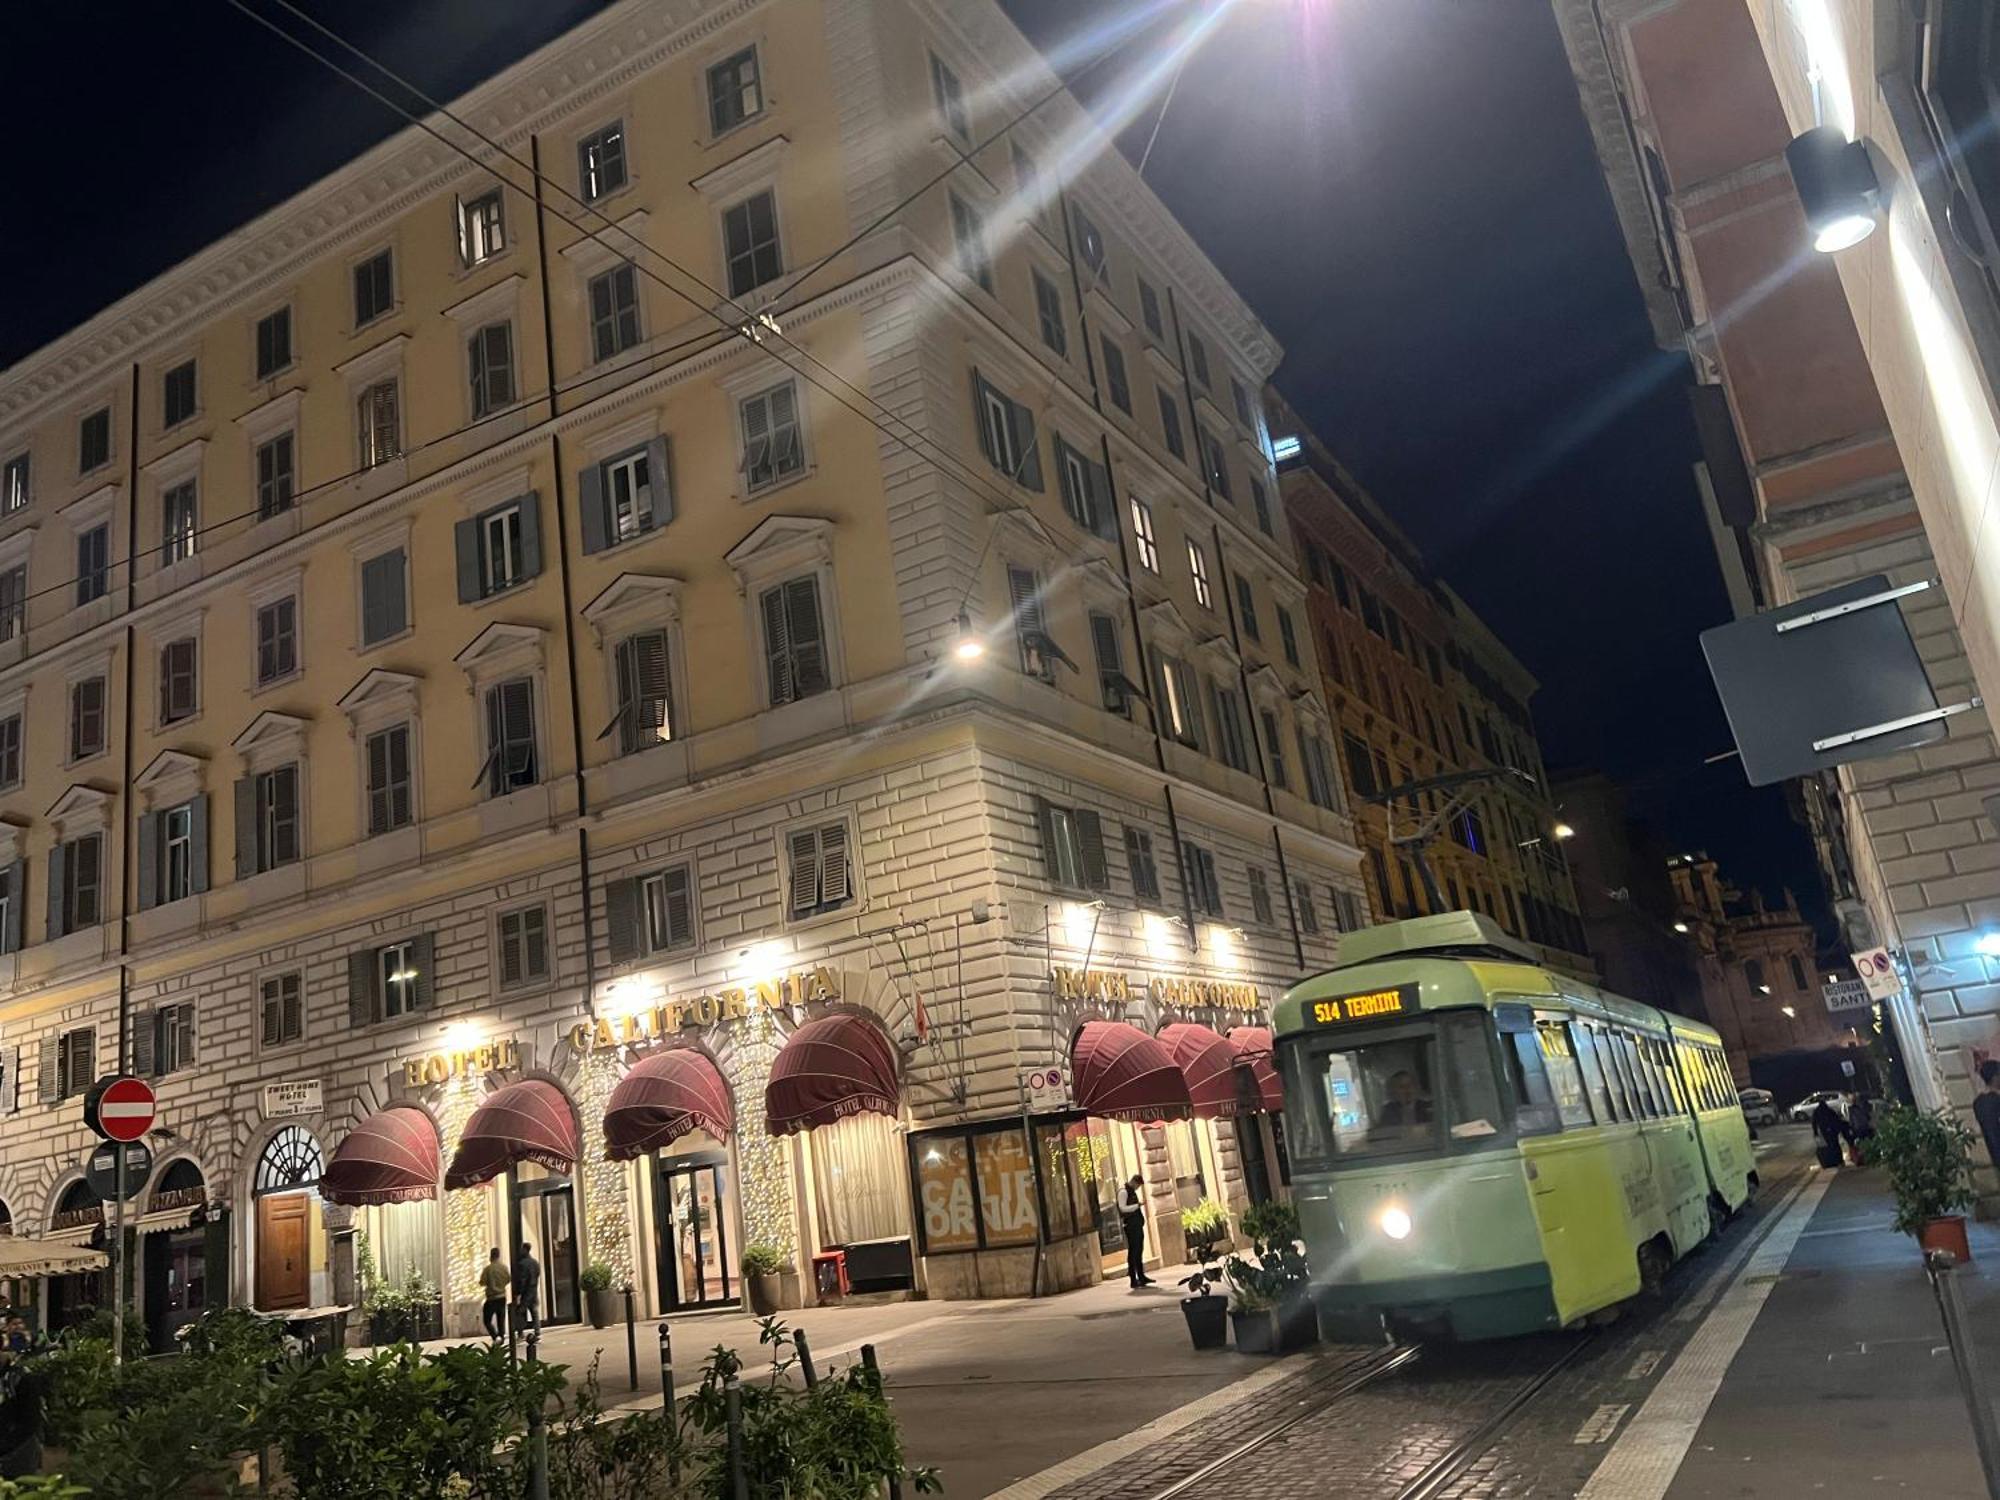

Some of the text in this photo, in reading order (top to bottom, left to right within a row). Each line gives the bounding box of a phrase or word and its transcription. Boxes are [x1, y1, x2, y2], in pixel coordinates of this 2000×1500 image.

[1054, 967, 1134, 1001] HOTEL
[1314, 991, 1402, 1022] 514 TERMINI
[403, 966, 840, 1088] HOTEL CALIFORNIA
[279, 1091, 307, 1101] HOTEL
[833, 1097, 862, 1118] HOTEL
[1115, 1107, 1166, 1121] CALIFORNIA
[667, 1116, 694, 1139] HOTEL
